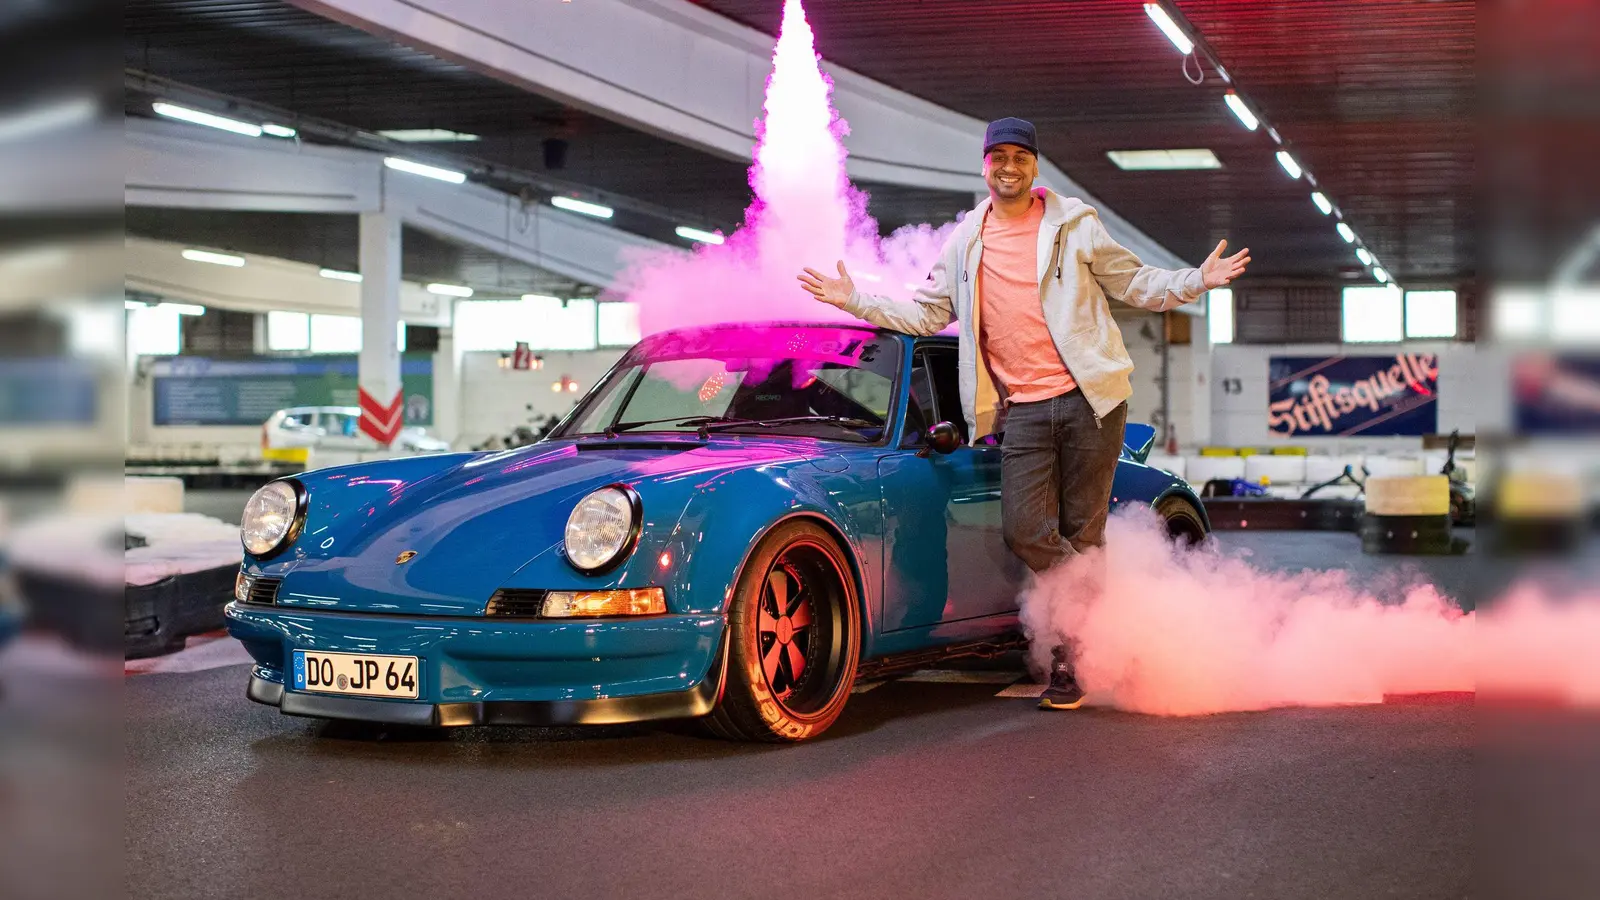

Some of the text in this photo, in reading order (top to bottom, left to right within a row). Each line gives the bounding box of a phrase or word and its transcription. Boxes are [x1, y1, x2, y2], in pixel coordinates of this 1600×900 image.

[1222, 377, 1242, 395] 13
[1268, 352, 1439, 439] Stiftsquelle
[297, 657, 415, 692] D DO JP 64
